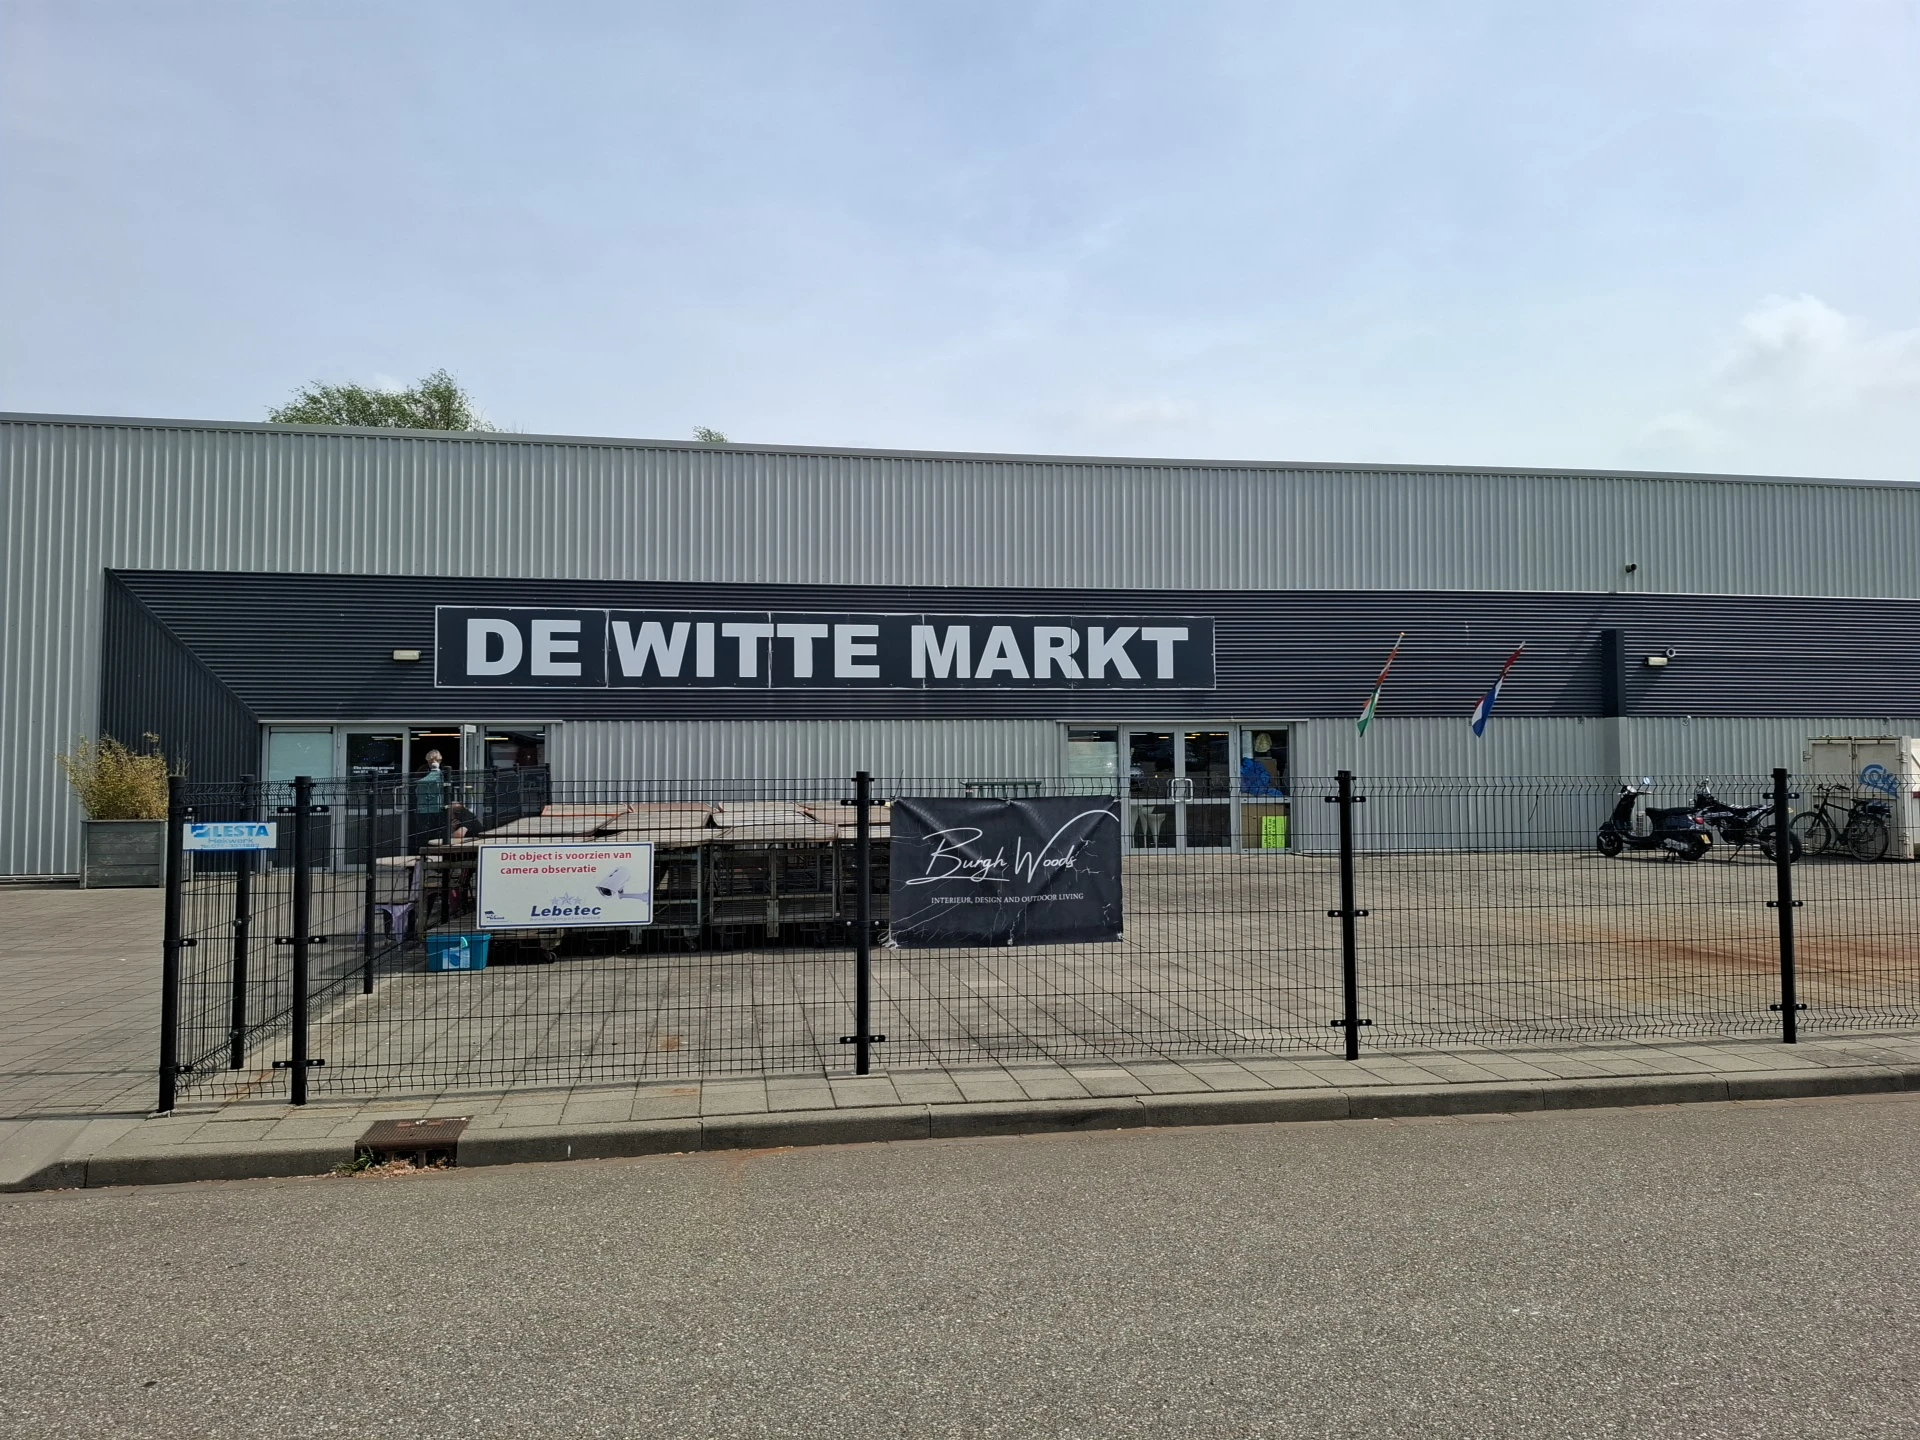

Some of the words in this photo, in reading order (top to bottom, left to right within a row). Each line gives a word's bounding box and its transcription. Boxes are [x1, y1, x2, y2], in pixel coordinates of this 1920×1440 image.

[466, 618, 582, 676] DE
[611, 621, 880, 679] WITTE
[911, 625, 1189, 679] MARKT
[212, 825, 269, 838] LESTA
[906, 827, 1010, 885] Burgh
[1015, 809, 1119, 883] Woods
[500, 852, 516, 861] Dit
[519, 852, 552, 862] object
[555, 851, 563, 860] is
[565, 851, 611, 860] voorzien
[613, 851, 632, 859] van
[500, 867, 539, 875] camera
[541, 864, 597, 874] observatie
[931, 896, 973, 905] INTERIEUR,
[974, 896, 1002, 904] DESIGN
[1021, 894, 1058, 903] OUTDOOR
[1058, 893, 1084, 901] LIVING
[530, 905, 602, 917] Lebetec
